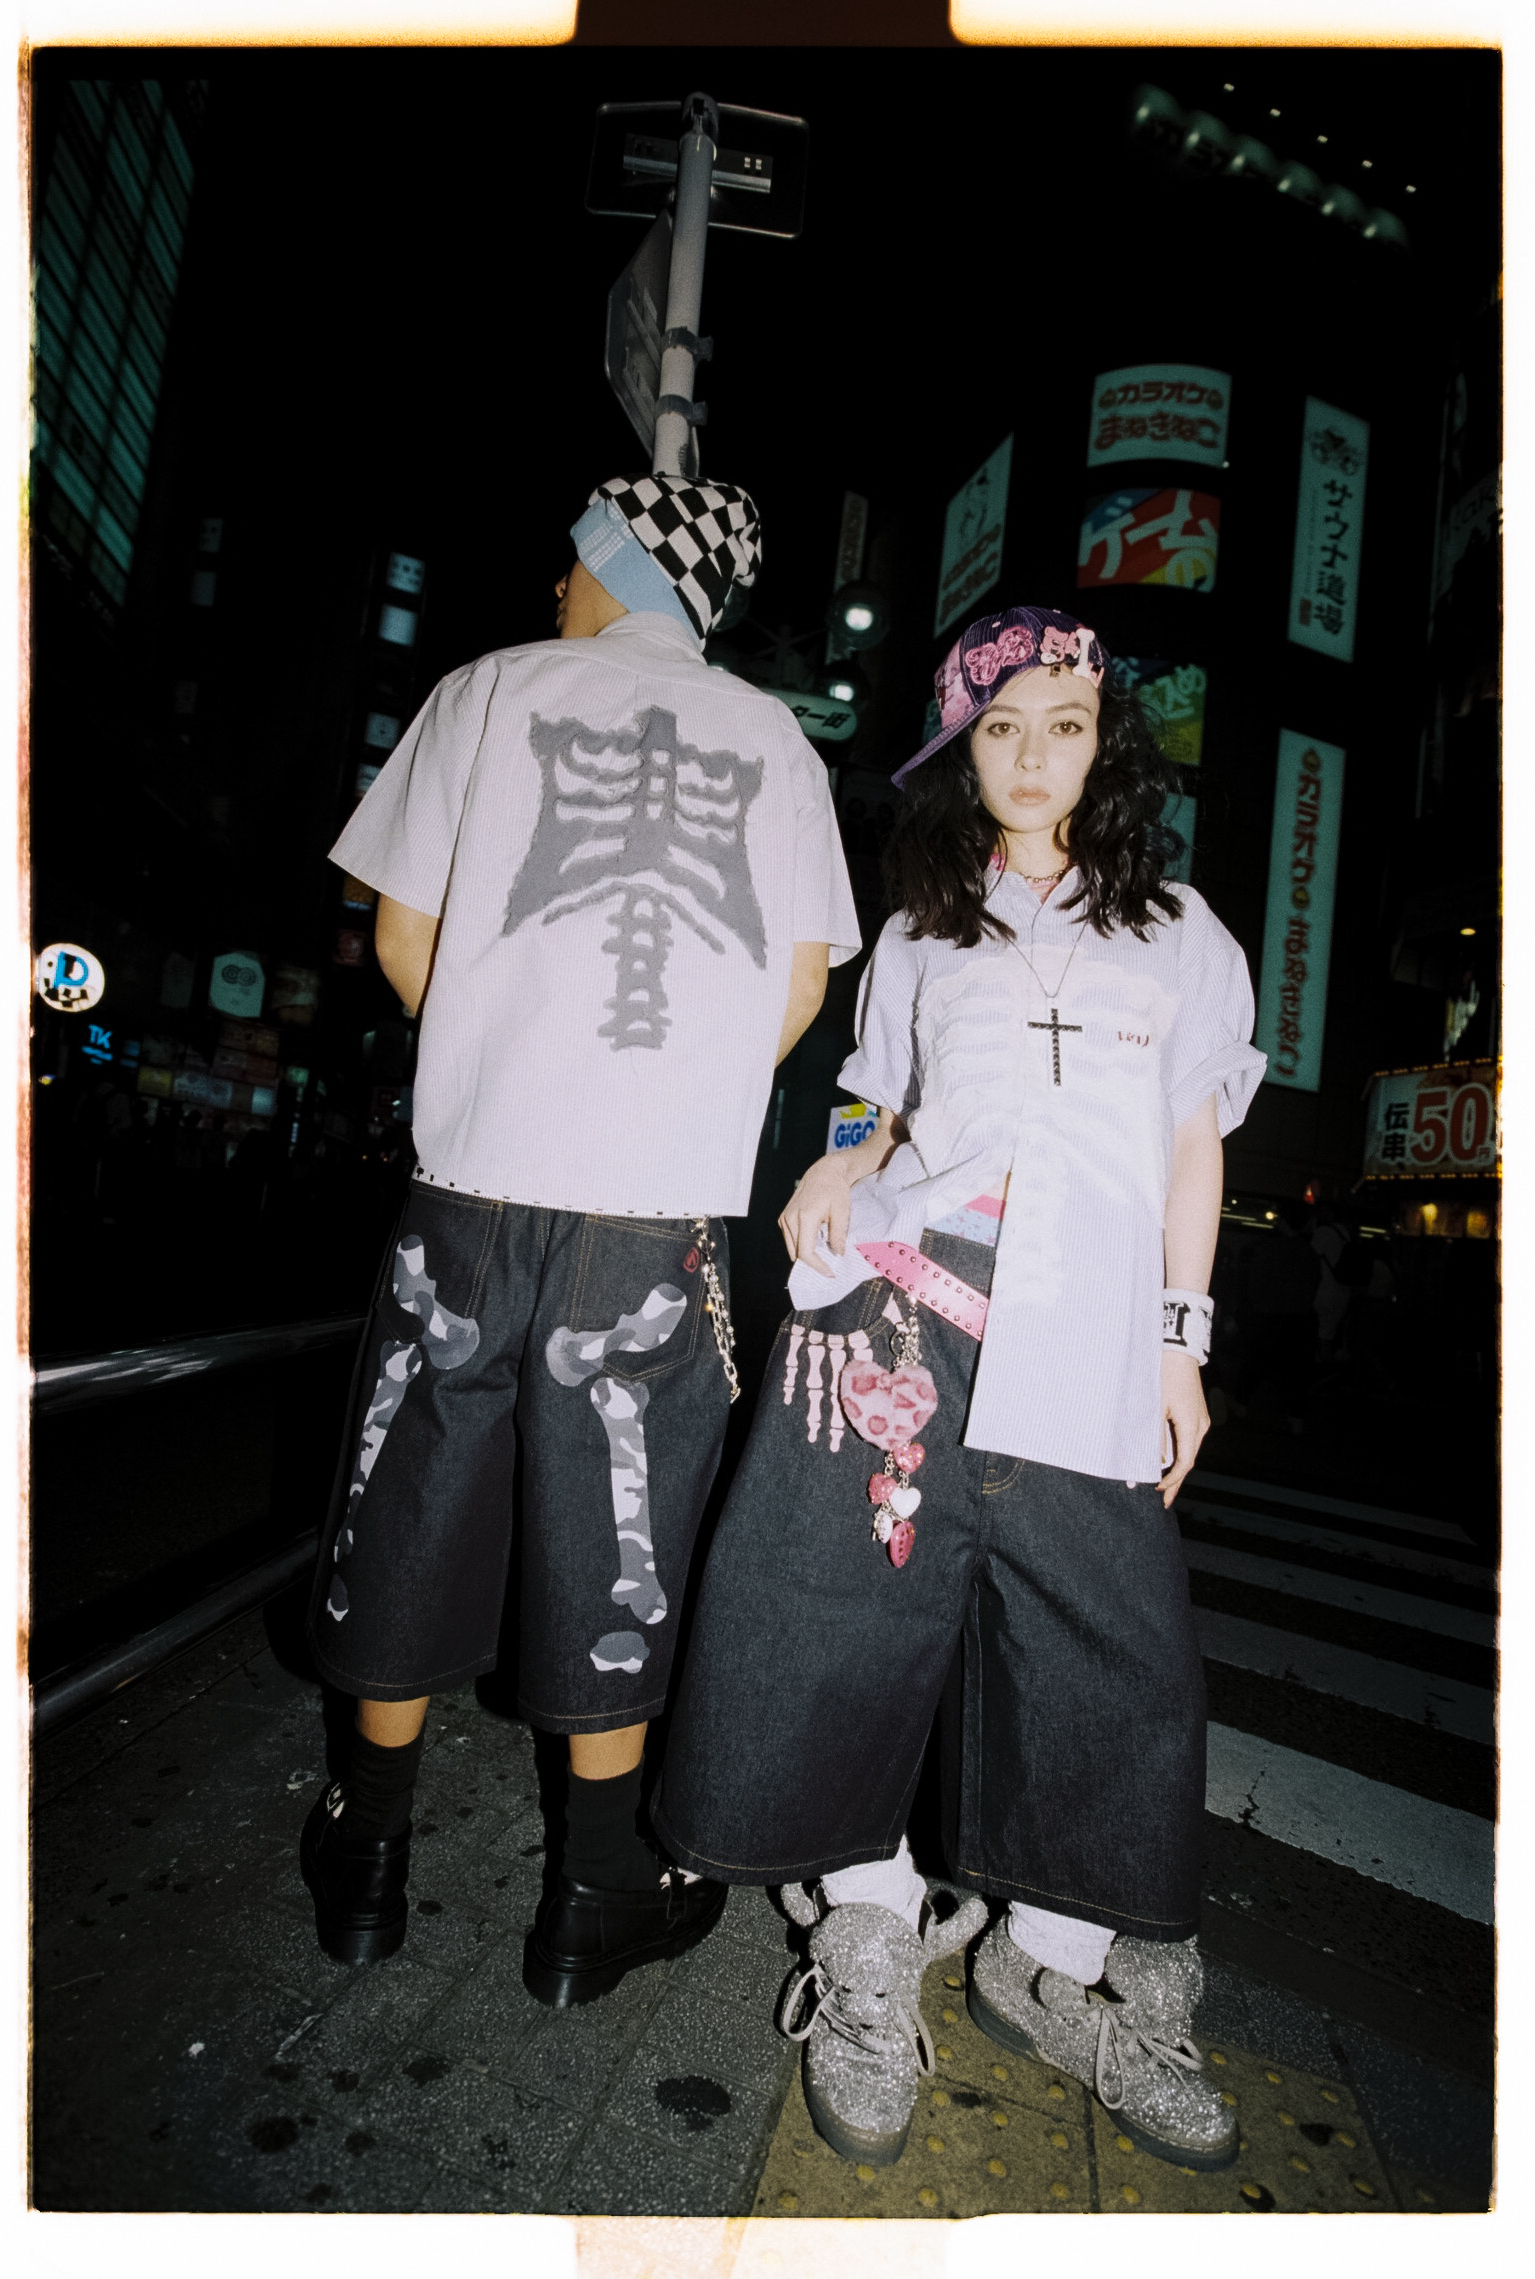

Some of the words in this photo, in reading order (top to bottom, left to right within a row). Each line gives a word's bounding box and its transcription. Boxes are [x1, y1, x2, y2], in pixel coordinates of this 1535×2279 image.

[1094, 410, 1221, 450] まねきねこ
[1116, 381, 1207, 405] カラオケ
[1313, 479, 1352, 635] サウナ道場
[1290, 775, 1321, 883] カラオケ
[1274, 916, 1309, 1075] まねきねこ
